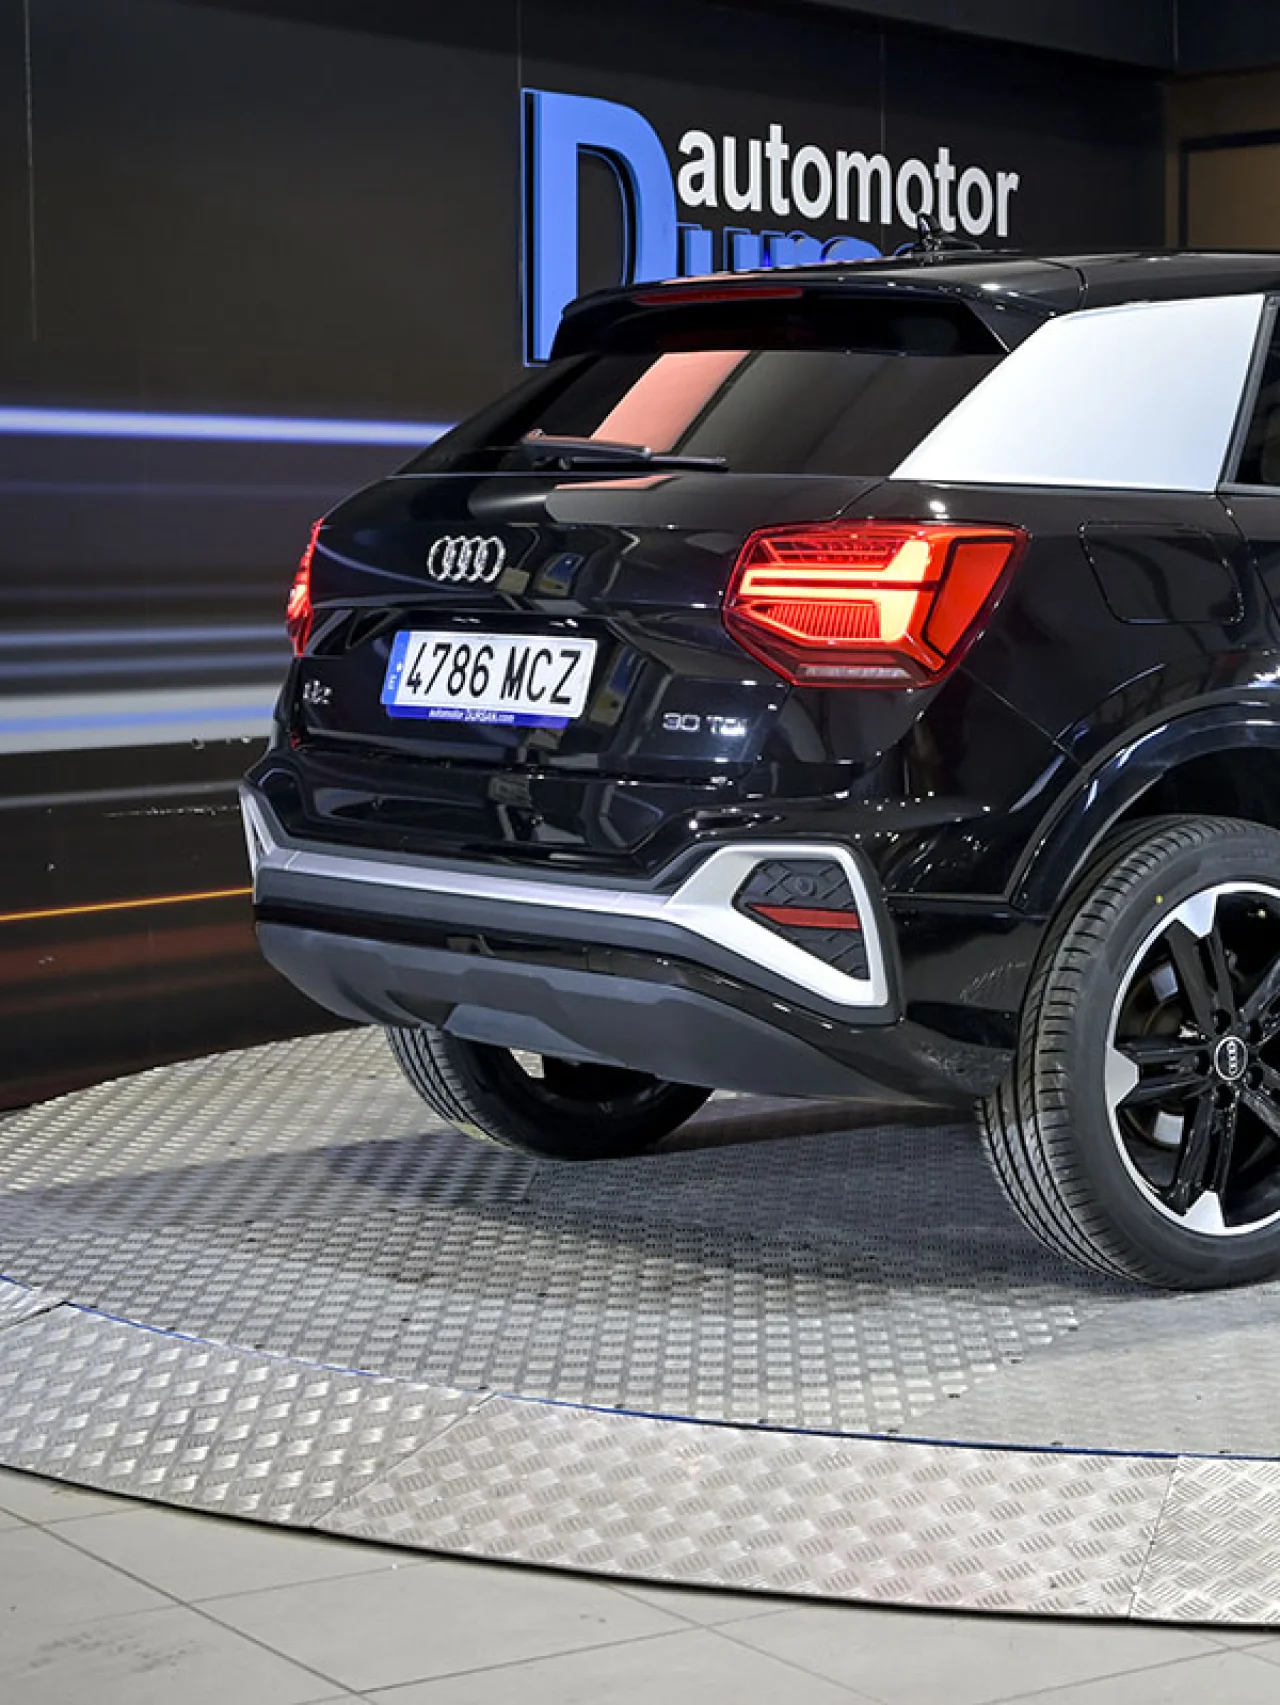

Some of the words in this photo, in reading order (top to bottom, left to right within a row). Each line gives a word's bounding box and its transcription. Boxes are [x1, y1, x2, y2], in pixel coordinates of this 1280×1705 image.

[677, 123, 1019, 237] automotor
[406, 642, 494, 698] 4786
[500, 646, 581, 704] MCZ
[662, 712, 700, 731] 30
